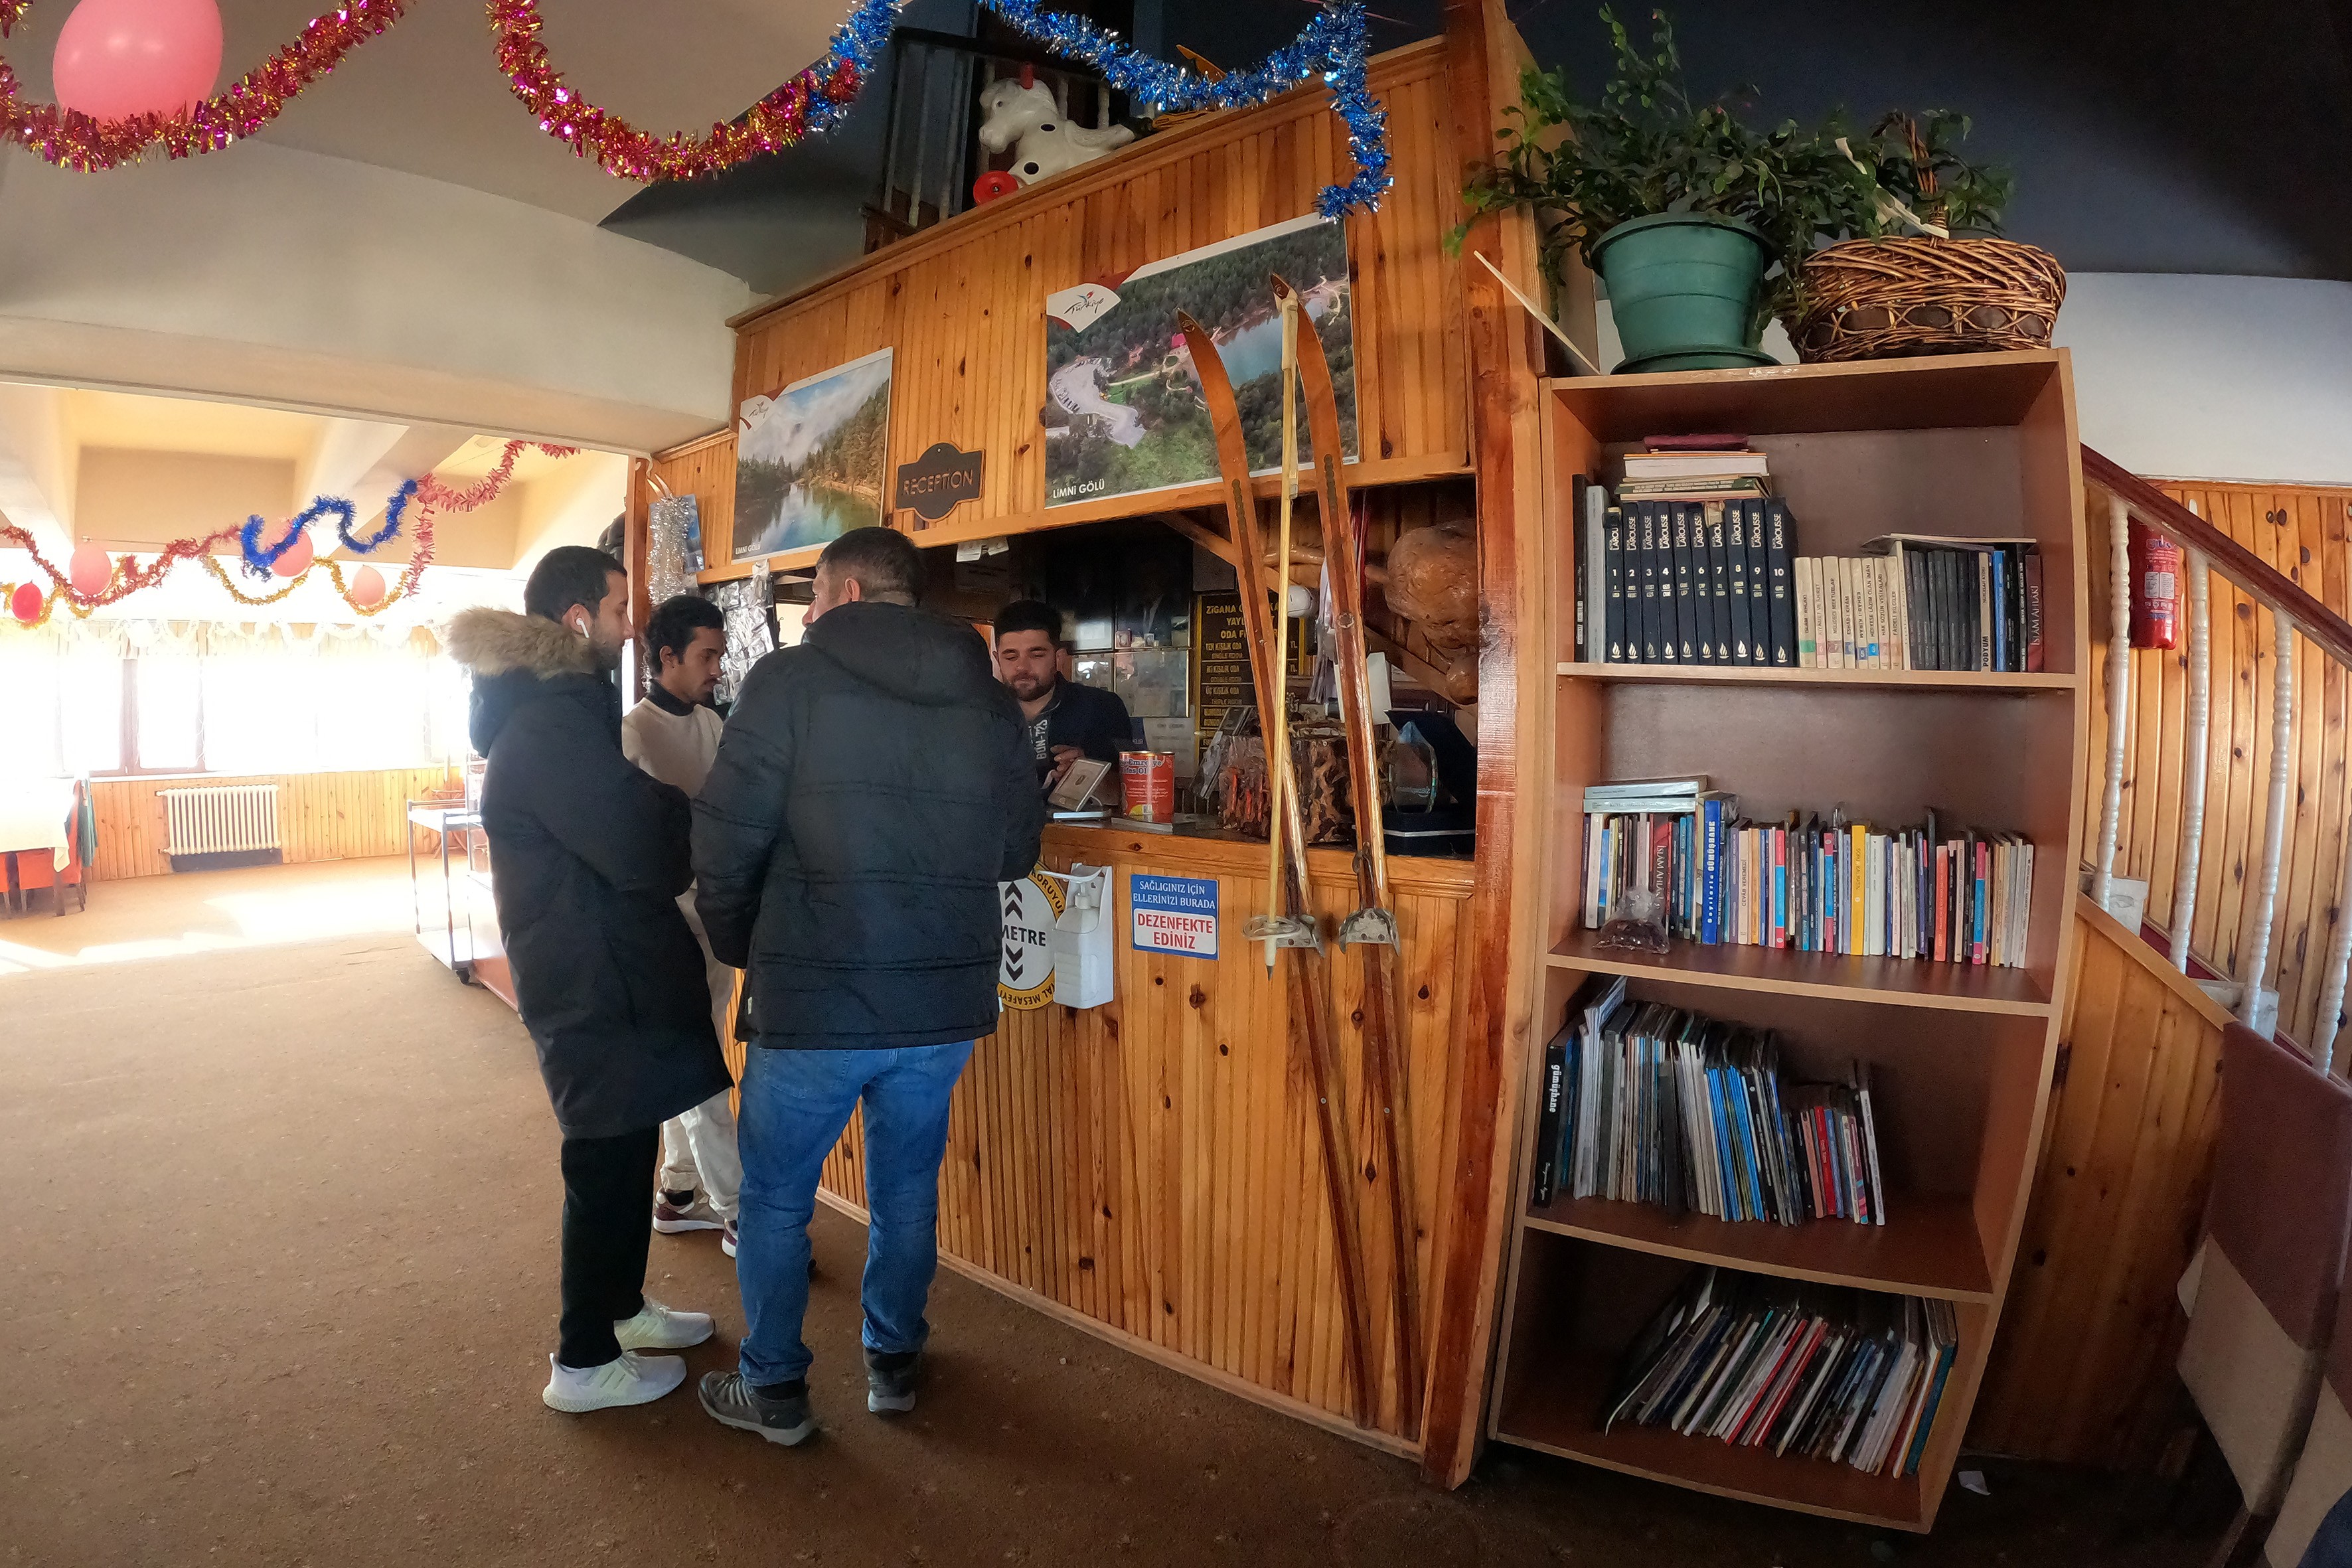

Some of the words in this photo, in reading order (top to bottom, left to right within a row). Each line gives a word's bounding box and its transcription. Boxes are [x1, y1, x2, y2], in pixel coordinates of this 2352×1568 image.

[1079, 478, 1105, 494] GÖLÜ
[1644, 515, 1653, 550] LAROUSSE
[1660, 514, 1670, 549] LAROUSSE
[1677, 512, 1687, 548] LAROUSSE
[1732, 510, 1742, 545] LAROUSSE
[1752, 512, 1762, 548] LAROUSSE
[1774, 513, 1783, 549] LAROUSSE
[1754, 566, 1761, 575] 9
[1133, 893, 1178, 905] ELLERİNİZİ
[1180, 897, 1215, 909] BURADA
[1188, 883, 1205, 896] İÇİN
[1137, 913, 1213, 934] DEZENFEKTE
[1153, 931, 1196, 949] EDİNİZ
[1549, 1064, 1562, 1113] gümüşhane
